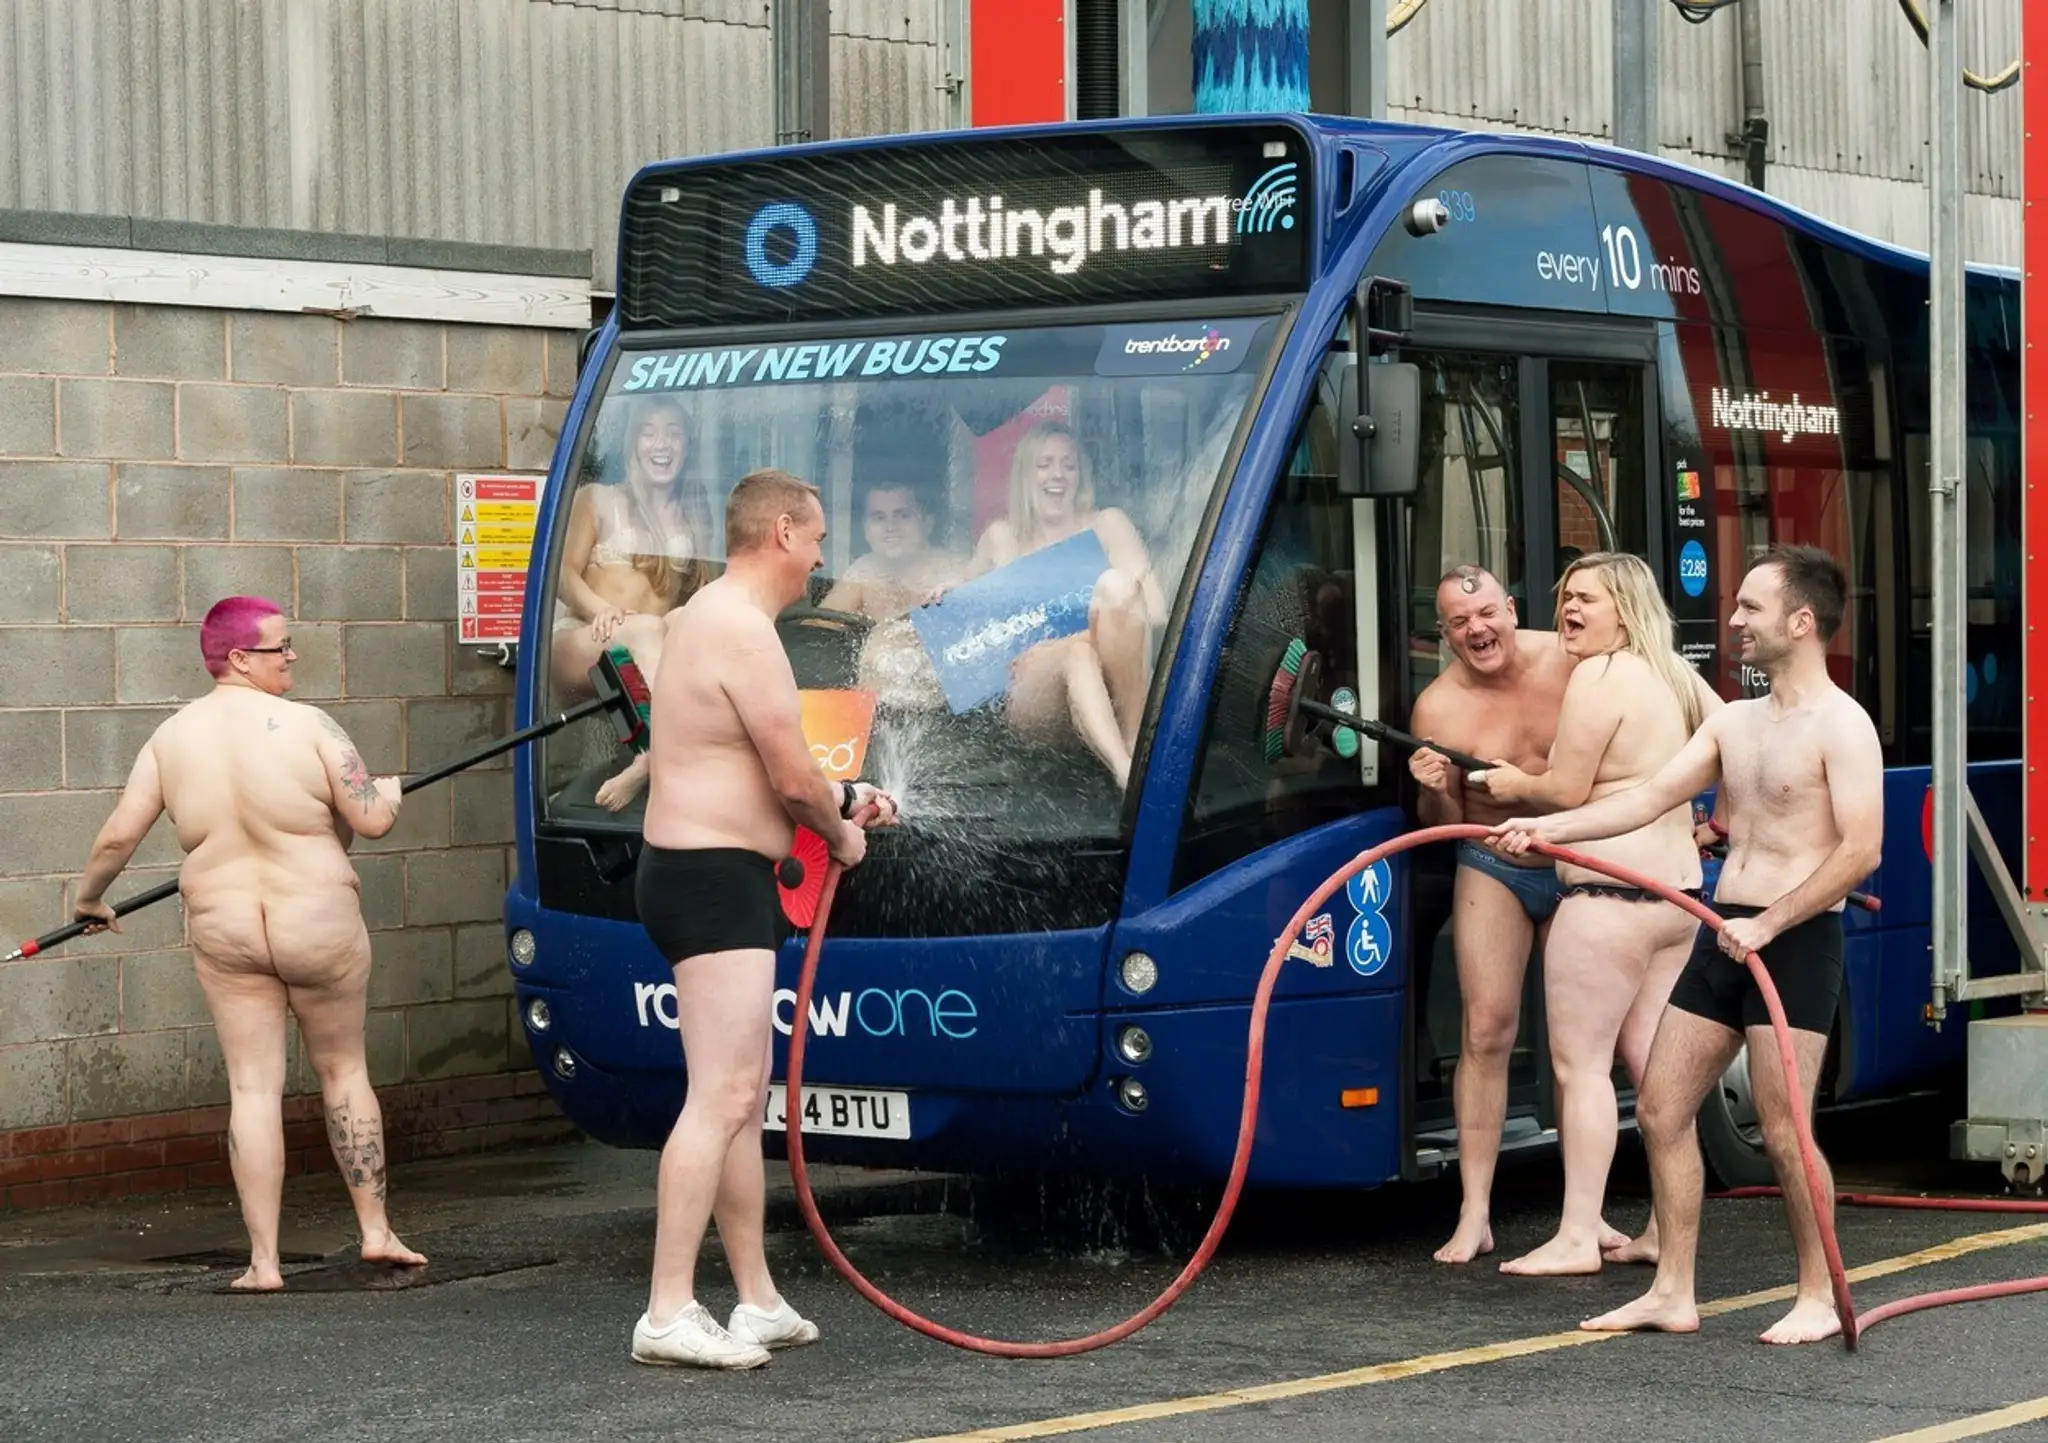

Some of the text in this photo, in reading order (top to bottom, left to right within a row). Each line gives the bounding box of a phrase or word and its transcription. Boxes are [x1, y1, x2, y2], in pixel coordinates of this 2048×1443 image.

[851, 188, 1230, 275] Nottingham
[1536, 224, 1701, 295] every 10 mins
[623, 335, 1008, 391] SHINY NEW BUSES
[1124, 333, 1230, 354] trentbarton
[1711, 387, 1840, 443] Nottingham
[856, 988, 977, 1038] one
[830, 1094, 890, 1130] BTU
